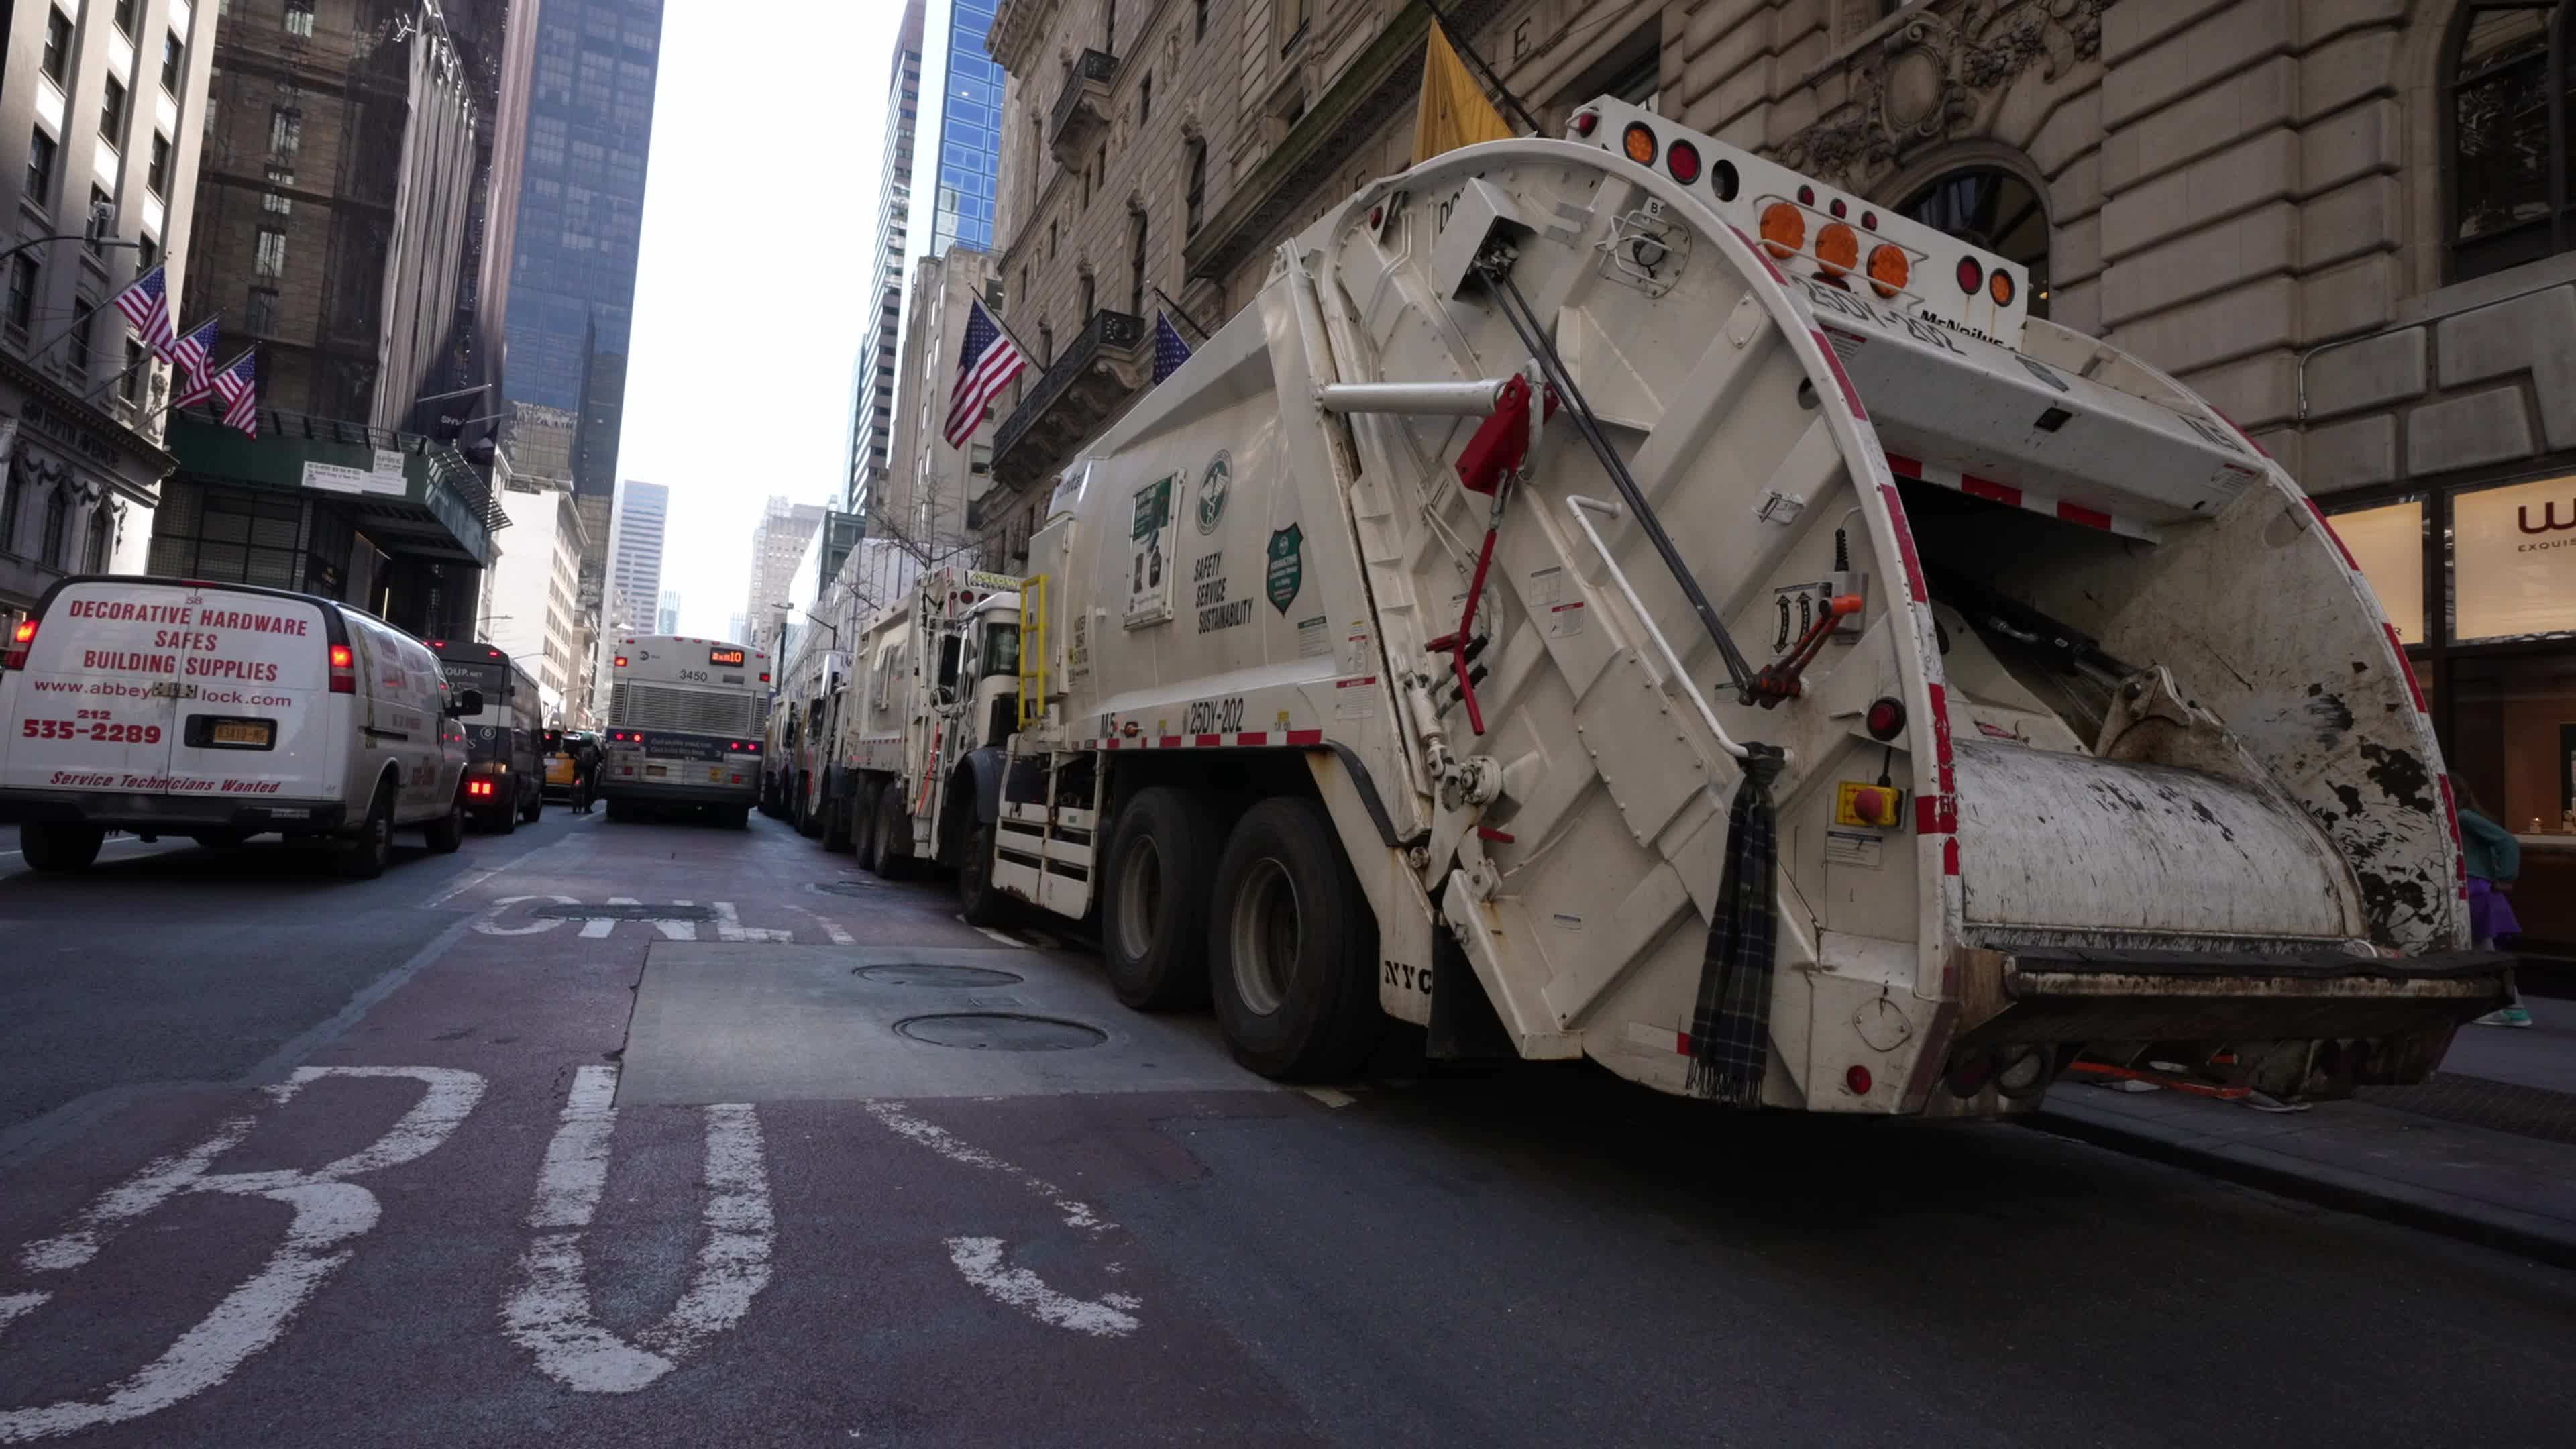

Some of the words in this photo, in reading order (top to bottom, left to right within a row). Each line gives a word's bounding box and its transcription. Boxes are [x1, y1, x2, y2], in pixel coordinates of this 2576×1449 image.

[1194, 550, 1223, 582] SAFETY
[1195, 577, 1227, 608] SERVICE
[69, 600, 192, 625] DECORATIVE
[199, 608, 309, 637] HARDWARE
[1198, 597, 1254, 635] SUSTAINABILITY
[154, 629, 218, 651] SAFES
[83, 649, 176, 674] BUILDING
[185, 657, 278, 682] SUPPLIES
[679, 669, 708, 682] 3450
[76, 709, 112, 720] 212
[1189, 698, 1244, 735] 25DY-202
[22, 718, 162, 745] 535-2289
[50, 771, 113, 787] Service
[121, 774, 215, 792] Technicians
[220, 778, 282, 793] Wanted
[1385, 960, 1432, 995] NYC
